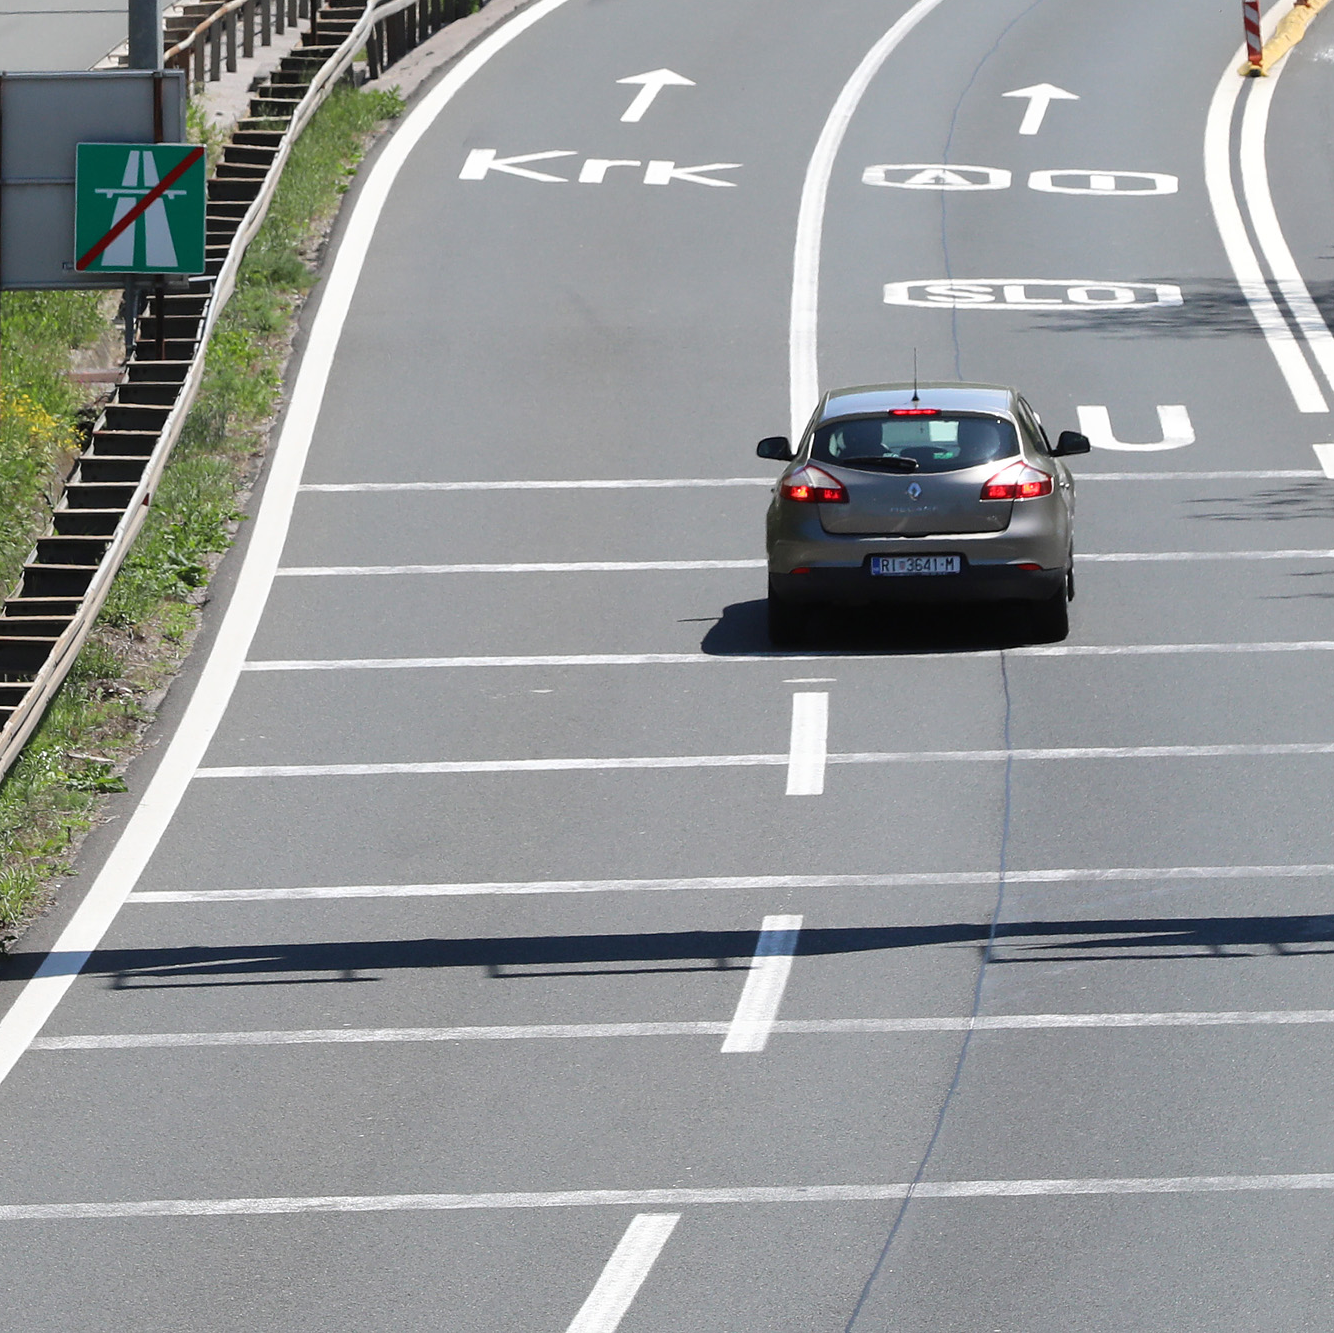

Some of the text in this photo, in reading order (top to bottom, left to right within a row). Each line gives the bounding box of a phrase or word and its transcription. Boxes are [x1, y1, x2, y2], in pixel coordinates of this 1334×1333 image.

[458, 148, 743, 188] Krk
[904, 168, 973, 185] A
[924, 284, 1136, 304] SLO
[1033, 405, 1196, 451] U
[881, 558, 896, 573] RI
